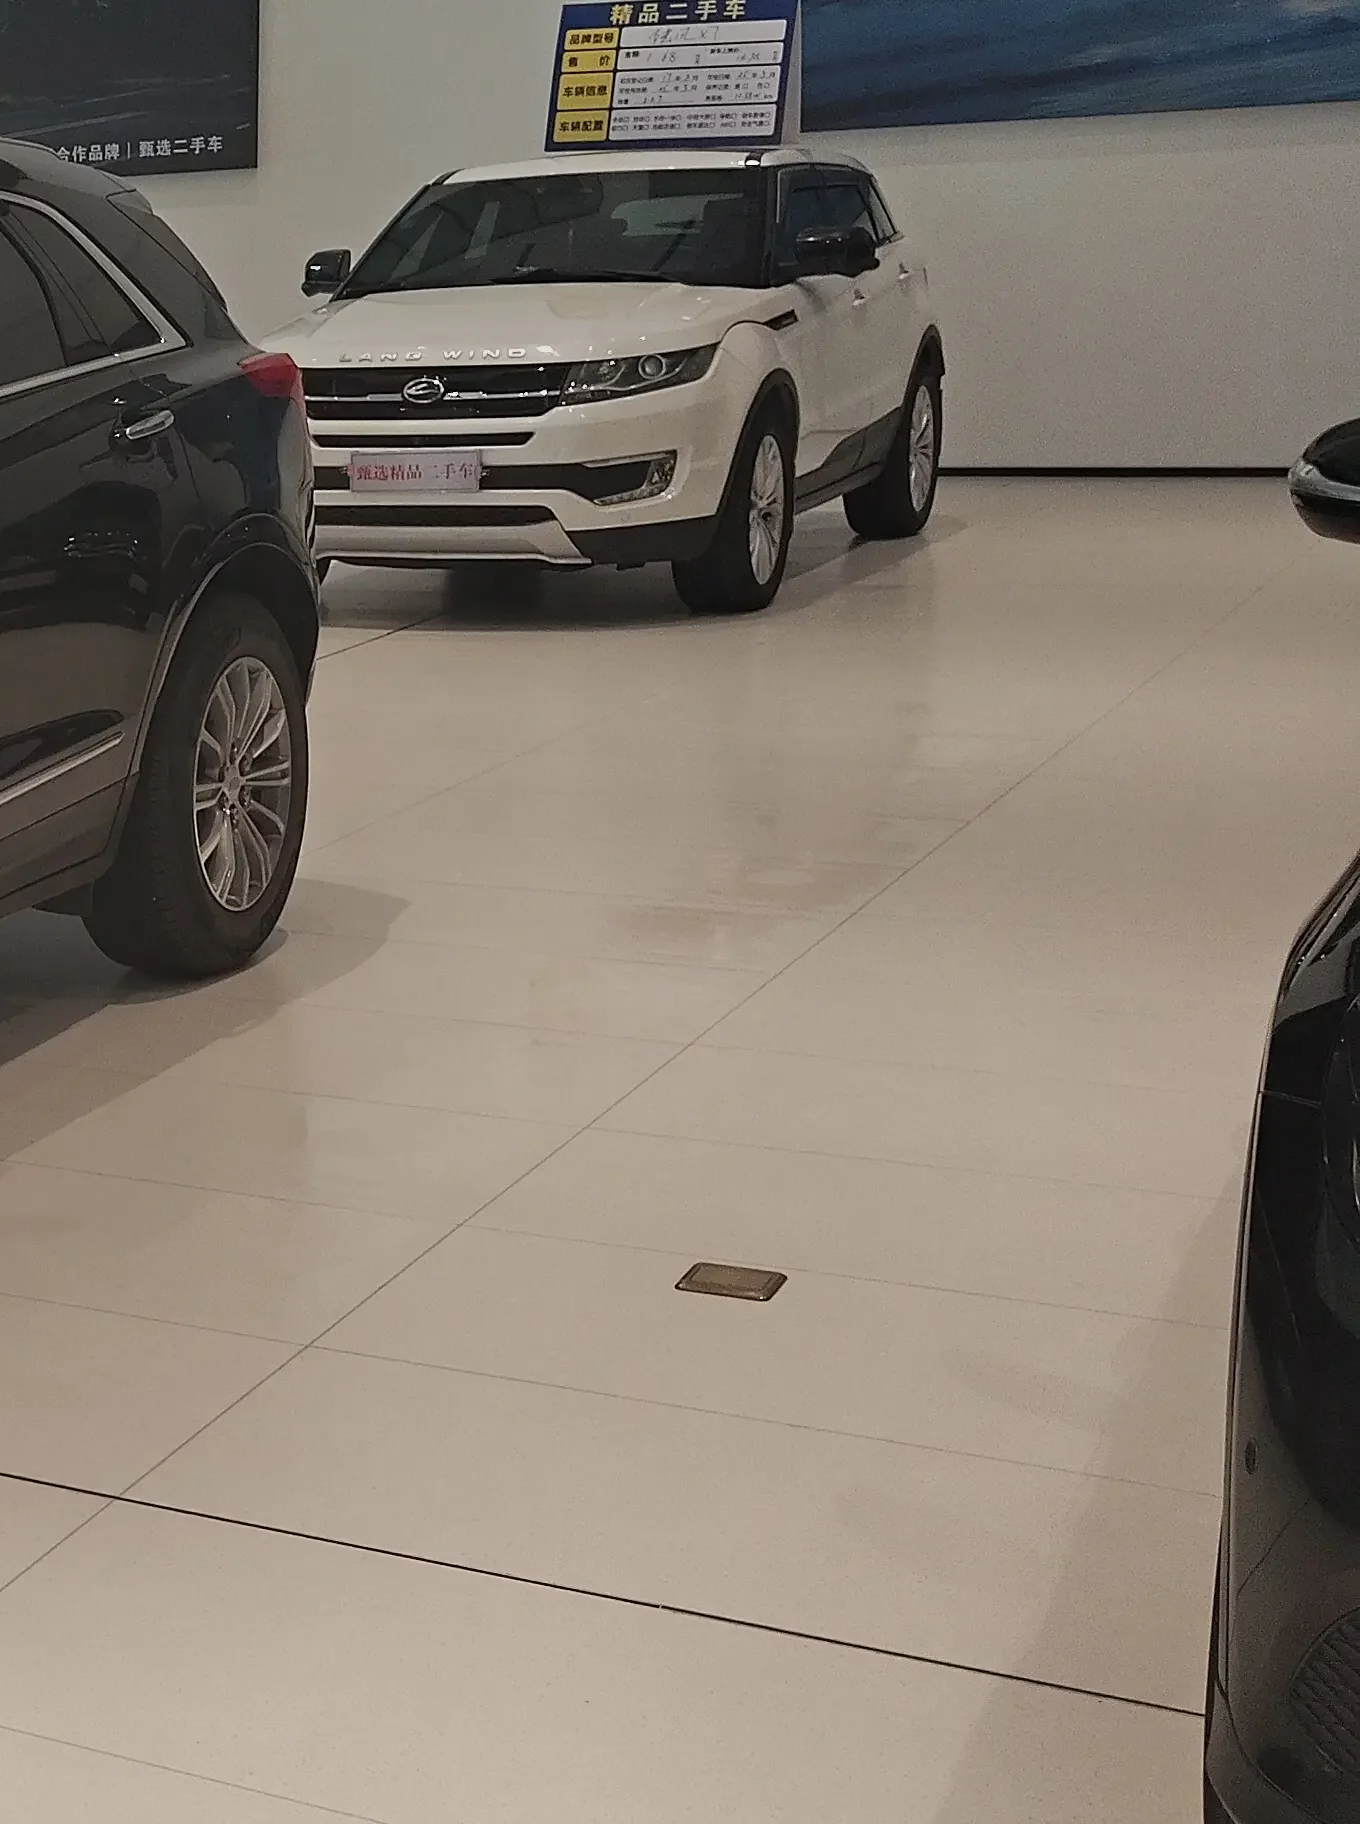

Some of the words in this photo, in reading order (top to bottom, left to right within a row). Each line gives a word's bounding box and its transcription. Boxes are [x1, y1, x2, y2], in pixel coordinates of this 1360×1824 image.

[609, 0, 746, 26] 精品二手车
[569, 32, 614, 45] 品牌型号
[599, 55, 610, 66] 价
[562, 85, 608, 98] 车辆信息
[559, 120, 603, 132] 车辆配置
[56, 142, 120, 163] 合作品牌
[139, 135, 223, 158] 甄选二手车
[339, 351, 422, 363] LAND
[443, 347, 526, 359] WIND
